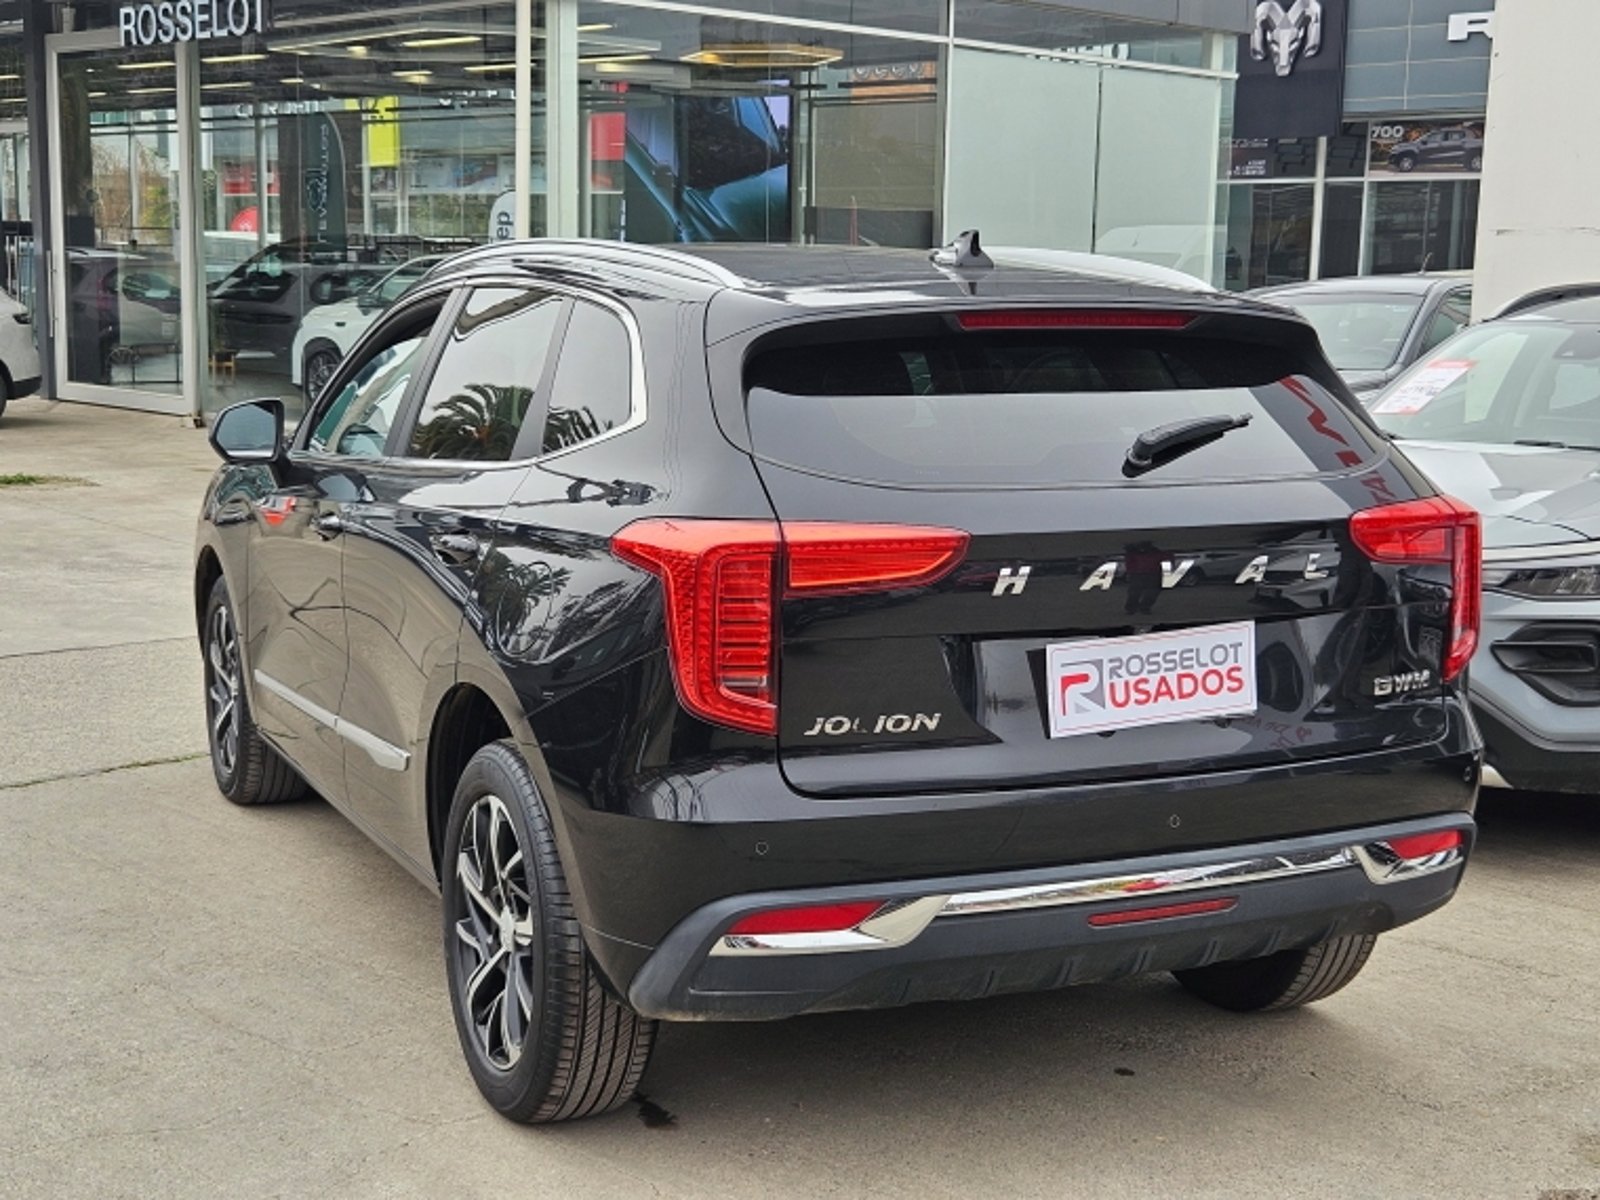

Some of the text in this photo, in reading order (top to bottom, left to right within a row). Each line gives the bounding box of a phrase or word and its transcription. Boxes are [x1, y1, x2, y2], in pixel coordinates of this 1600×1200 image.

[119, 0, 262, 47] ROSSELOT
[1371, 125, 1404, 138] 700
[992, 554, 1329, 596] HAVAL
[1108, 642, 1243, 680] ROSSELOT
[1108, 666, 1244, 708] USADOS
[1373, 669, 1430, 696] GWM
[803, 713, 942, 736] JOLION
